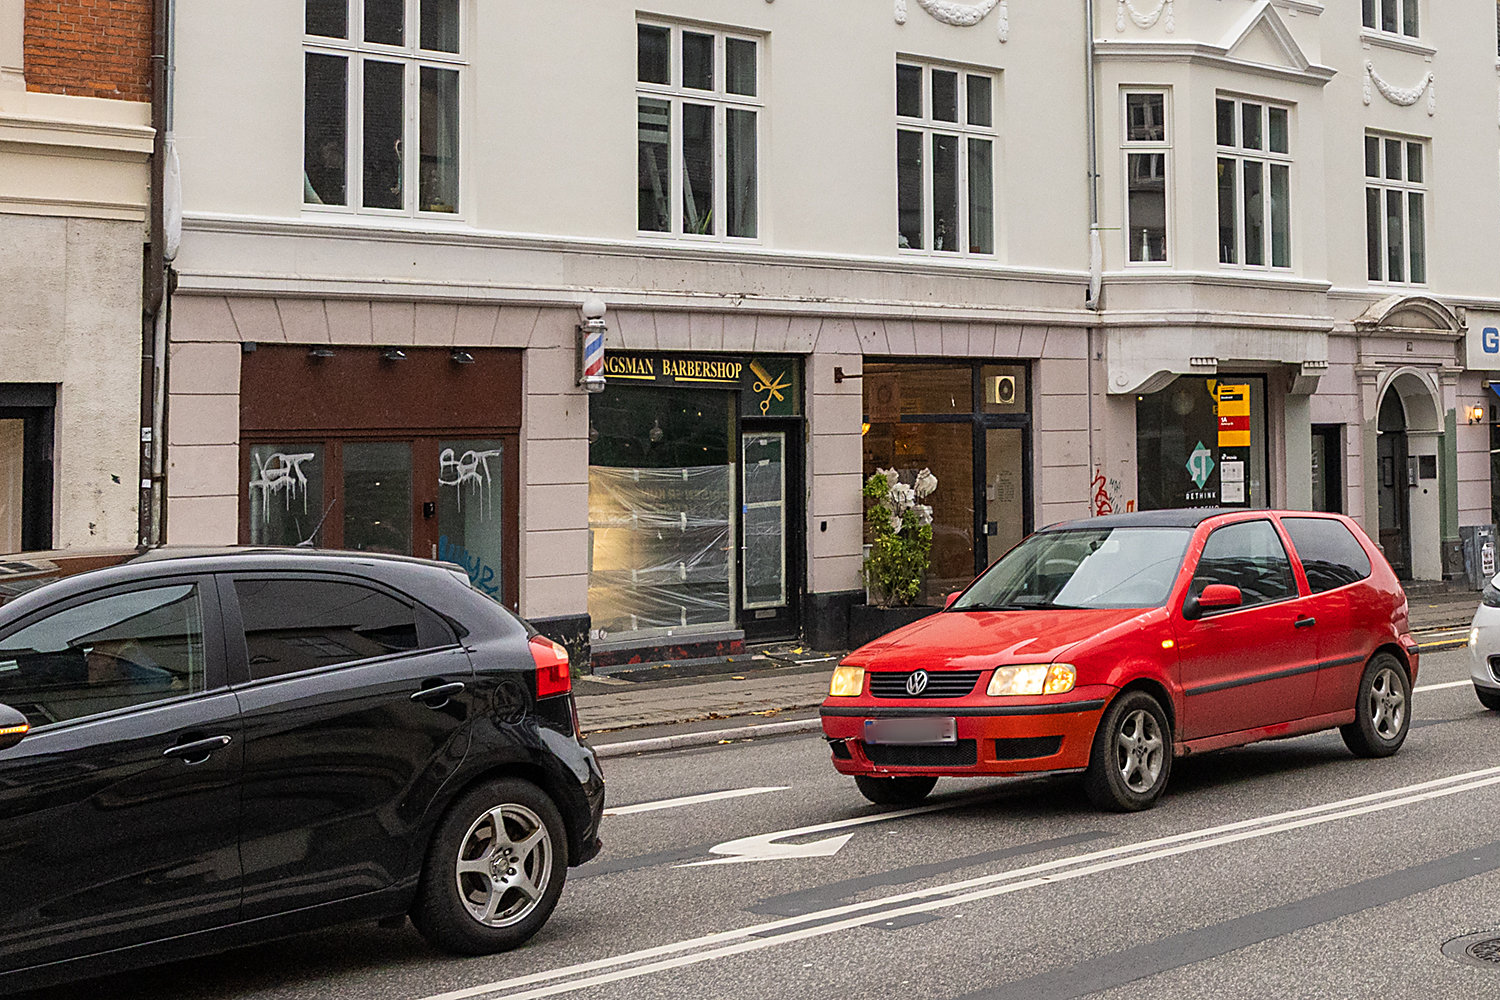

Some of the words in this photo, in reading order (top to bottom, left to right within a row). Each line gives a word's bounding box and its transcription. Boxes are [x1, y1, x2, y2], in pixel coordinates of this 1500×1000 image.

[604, 356, 654, 374] NGSMAN
[662, 359, 742, 379] BARBERSHOP
[1185, 492, 1216, 500] RETHINK
